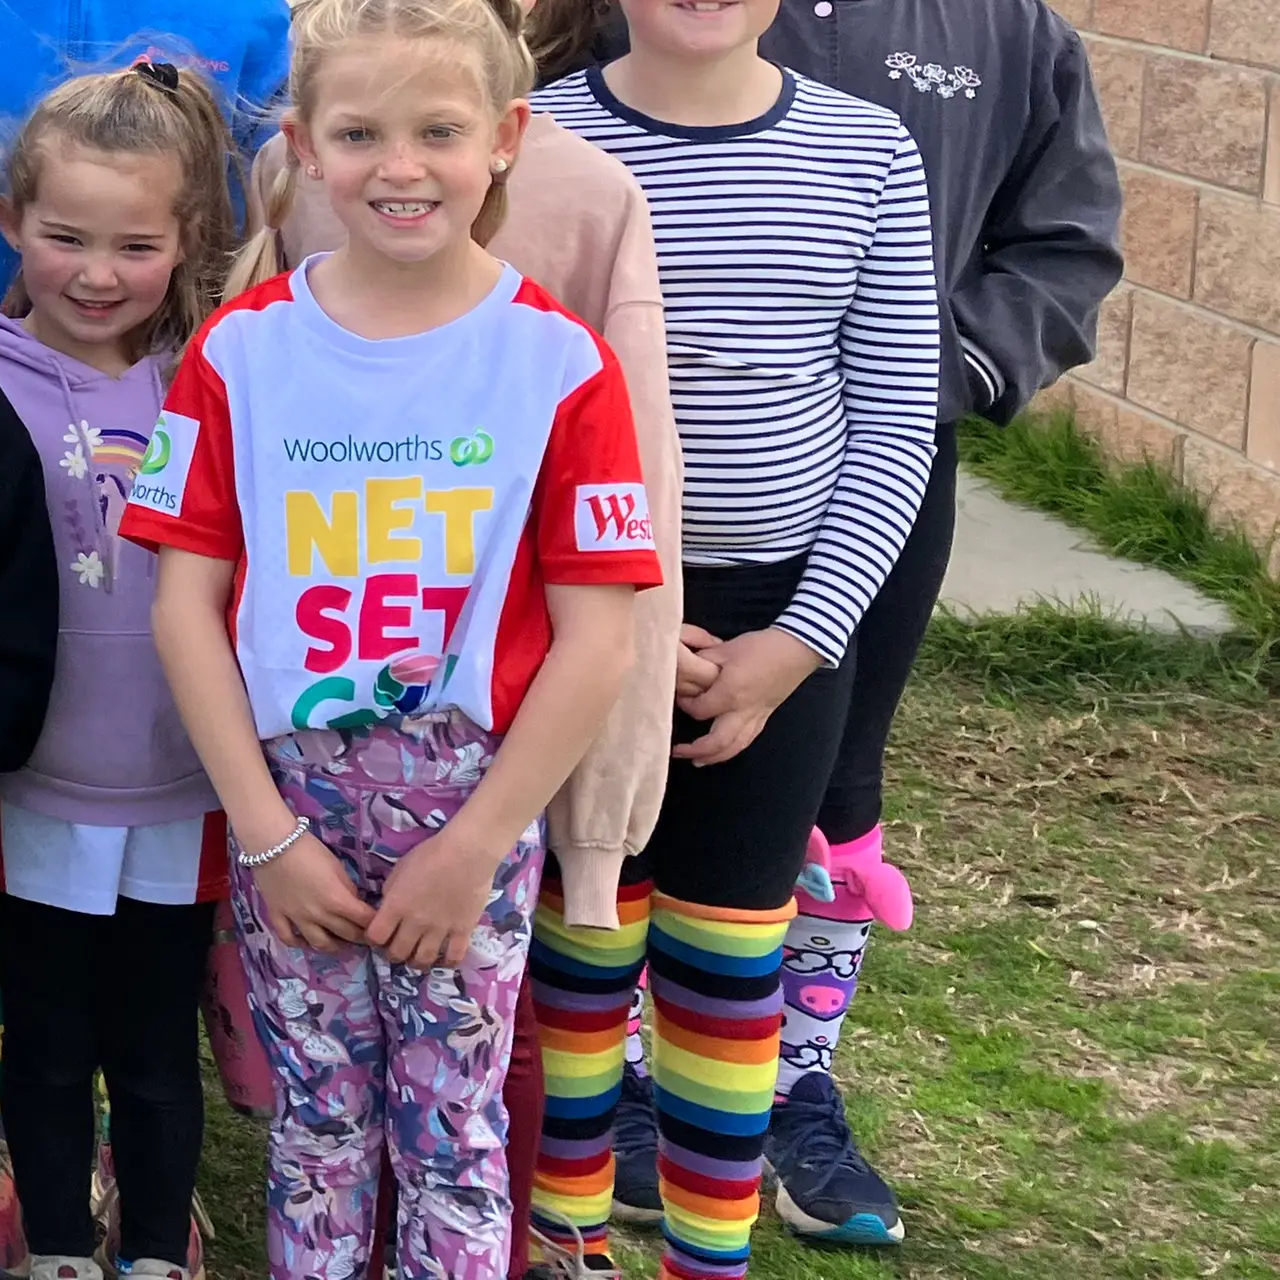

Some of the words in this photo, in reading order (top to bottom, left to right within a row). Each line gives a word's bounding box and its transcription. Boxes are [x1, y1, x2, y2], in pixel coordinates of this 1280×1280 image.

[283, 434, 443, 462] Woolworths
[285, 476, 494, 577] NET
[295, 573, 472, 674] SET
